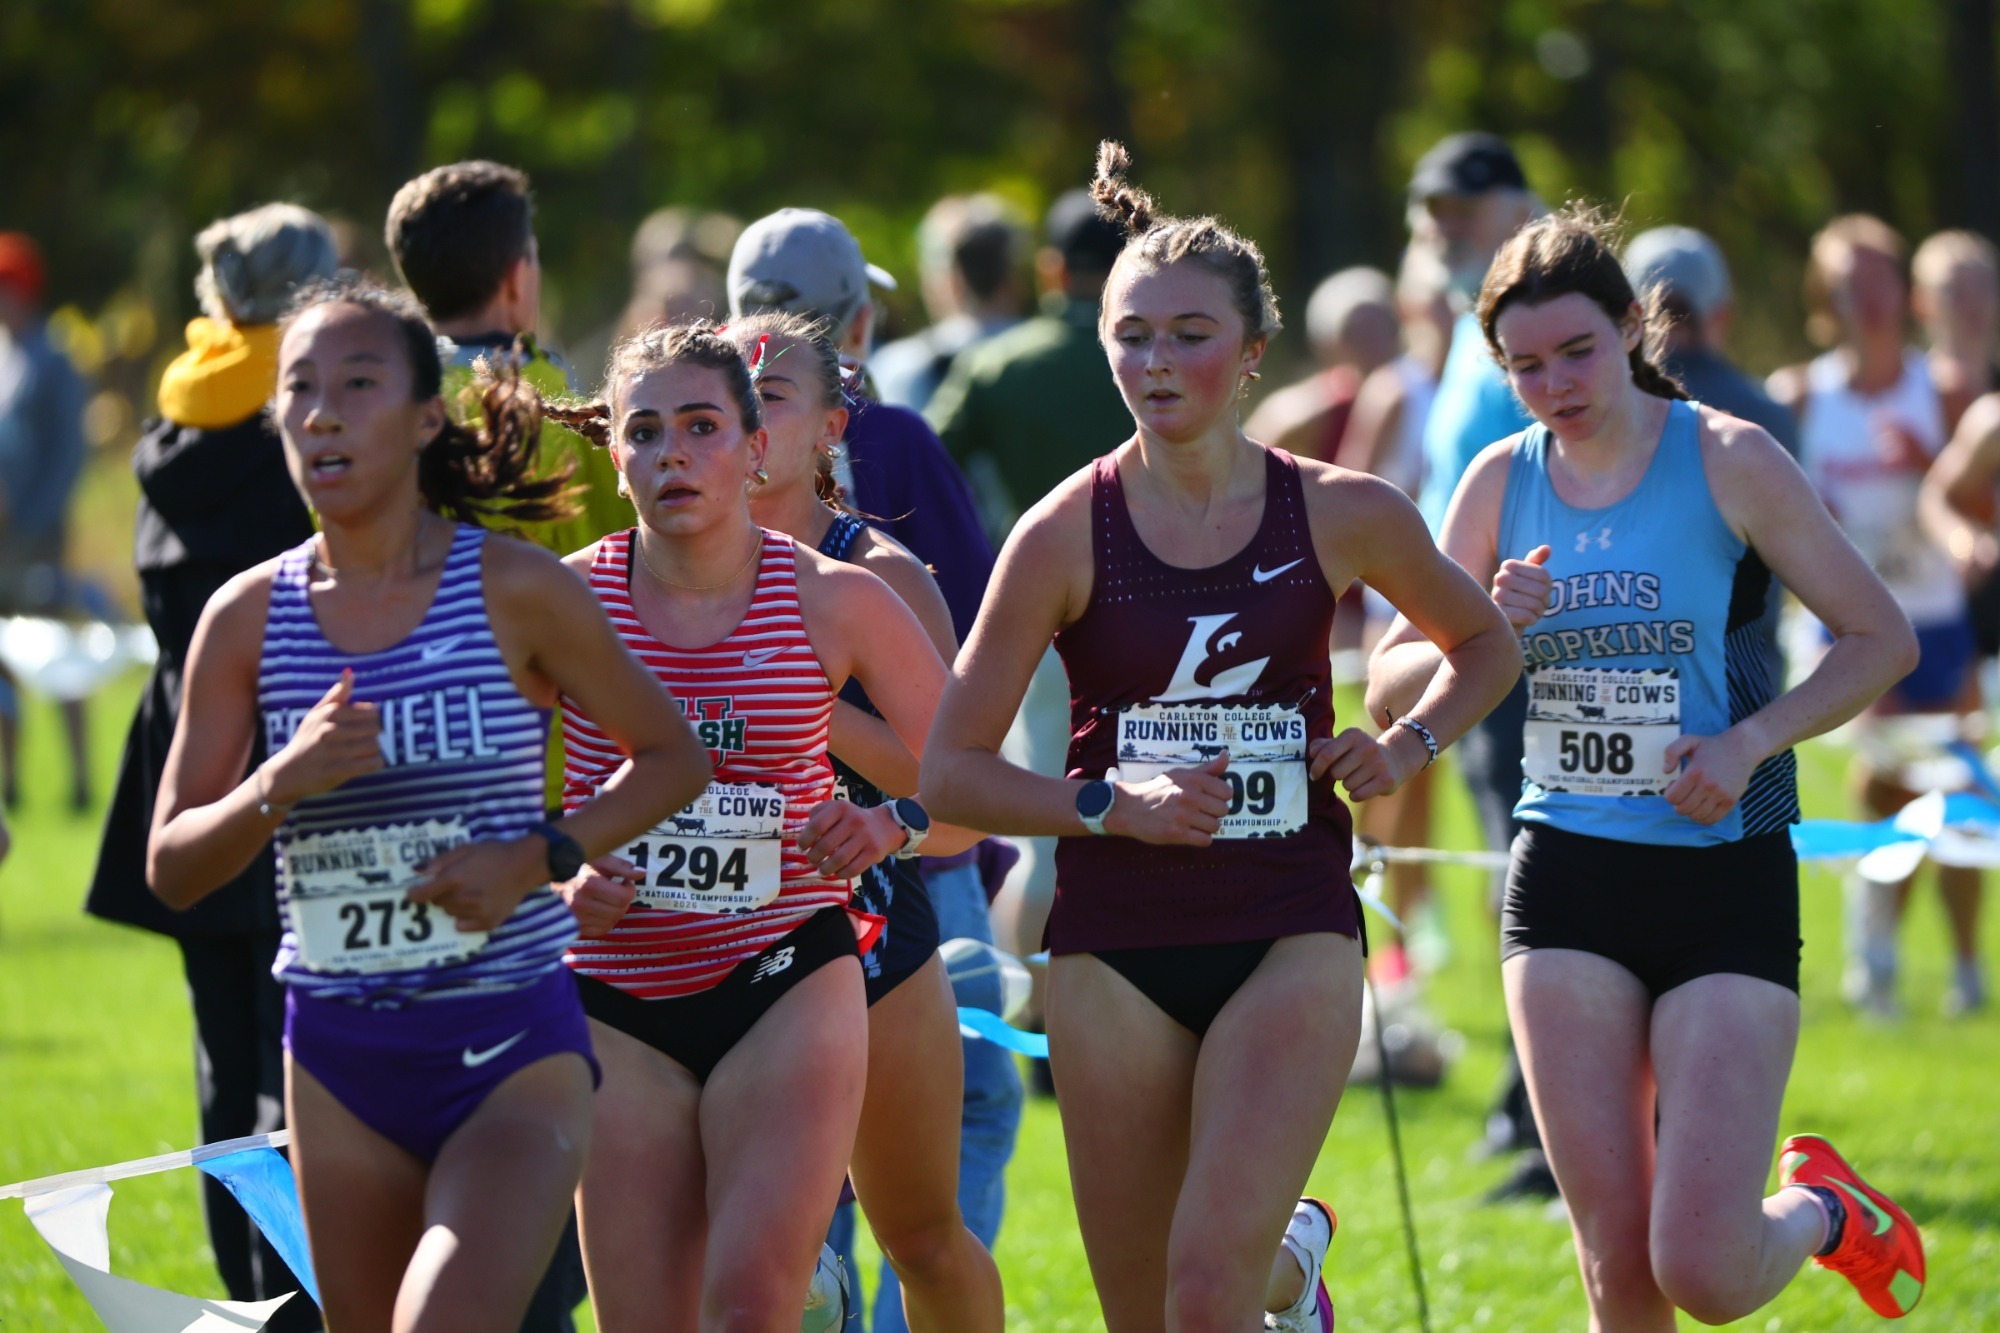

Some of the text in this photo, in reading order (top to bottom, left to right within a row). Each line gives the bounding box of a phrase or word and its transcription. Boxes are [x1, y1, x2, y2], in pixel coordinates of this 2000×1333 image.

[1543, 571, 1660, 617] OHNS
[1533, 682, 1597, 703] RUNNING
[1616, 685, 1676, 704] COWS
[1159, 711, 1272, 721] CARLETON COLLEGE
[1124, 720, 1302, 741] RUNNING COWS
[1559, 730, 1634, 775] 508
[703, 786, 750, 796] OLLEGE
[719, 796, 782, 817] COWS
[628, 842, 749, 892] 1294
[636, 889, 753, 903] E-NATIONAL CHAMPIONSHIP
[340, 896, 432, 950] 273
